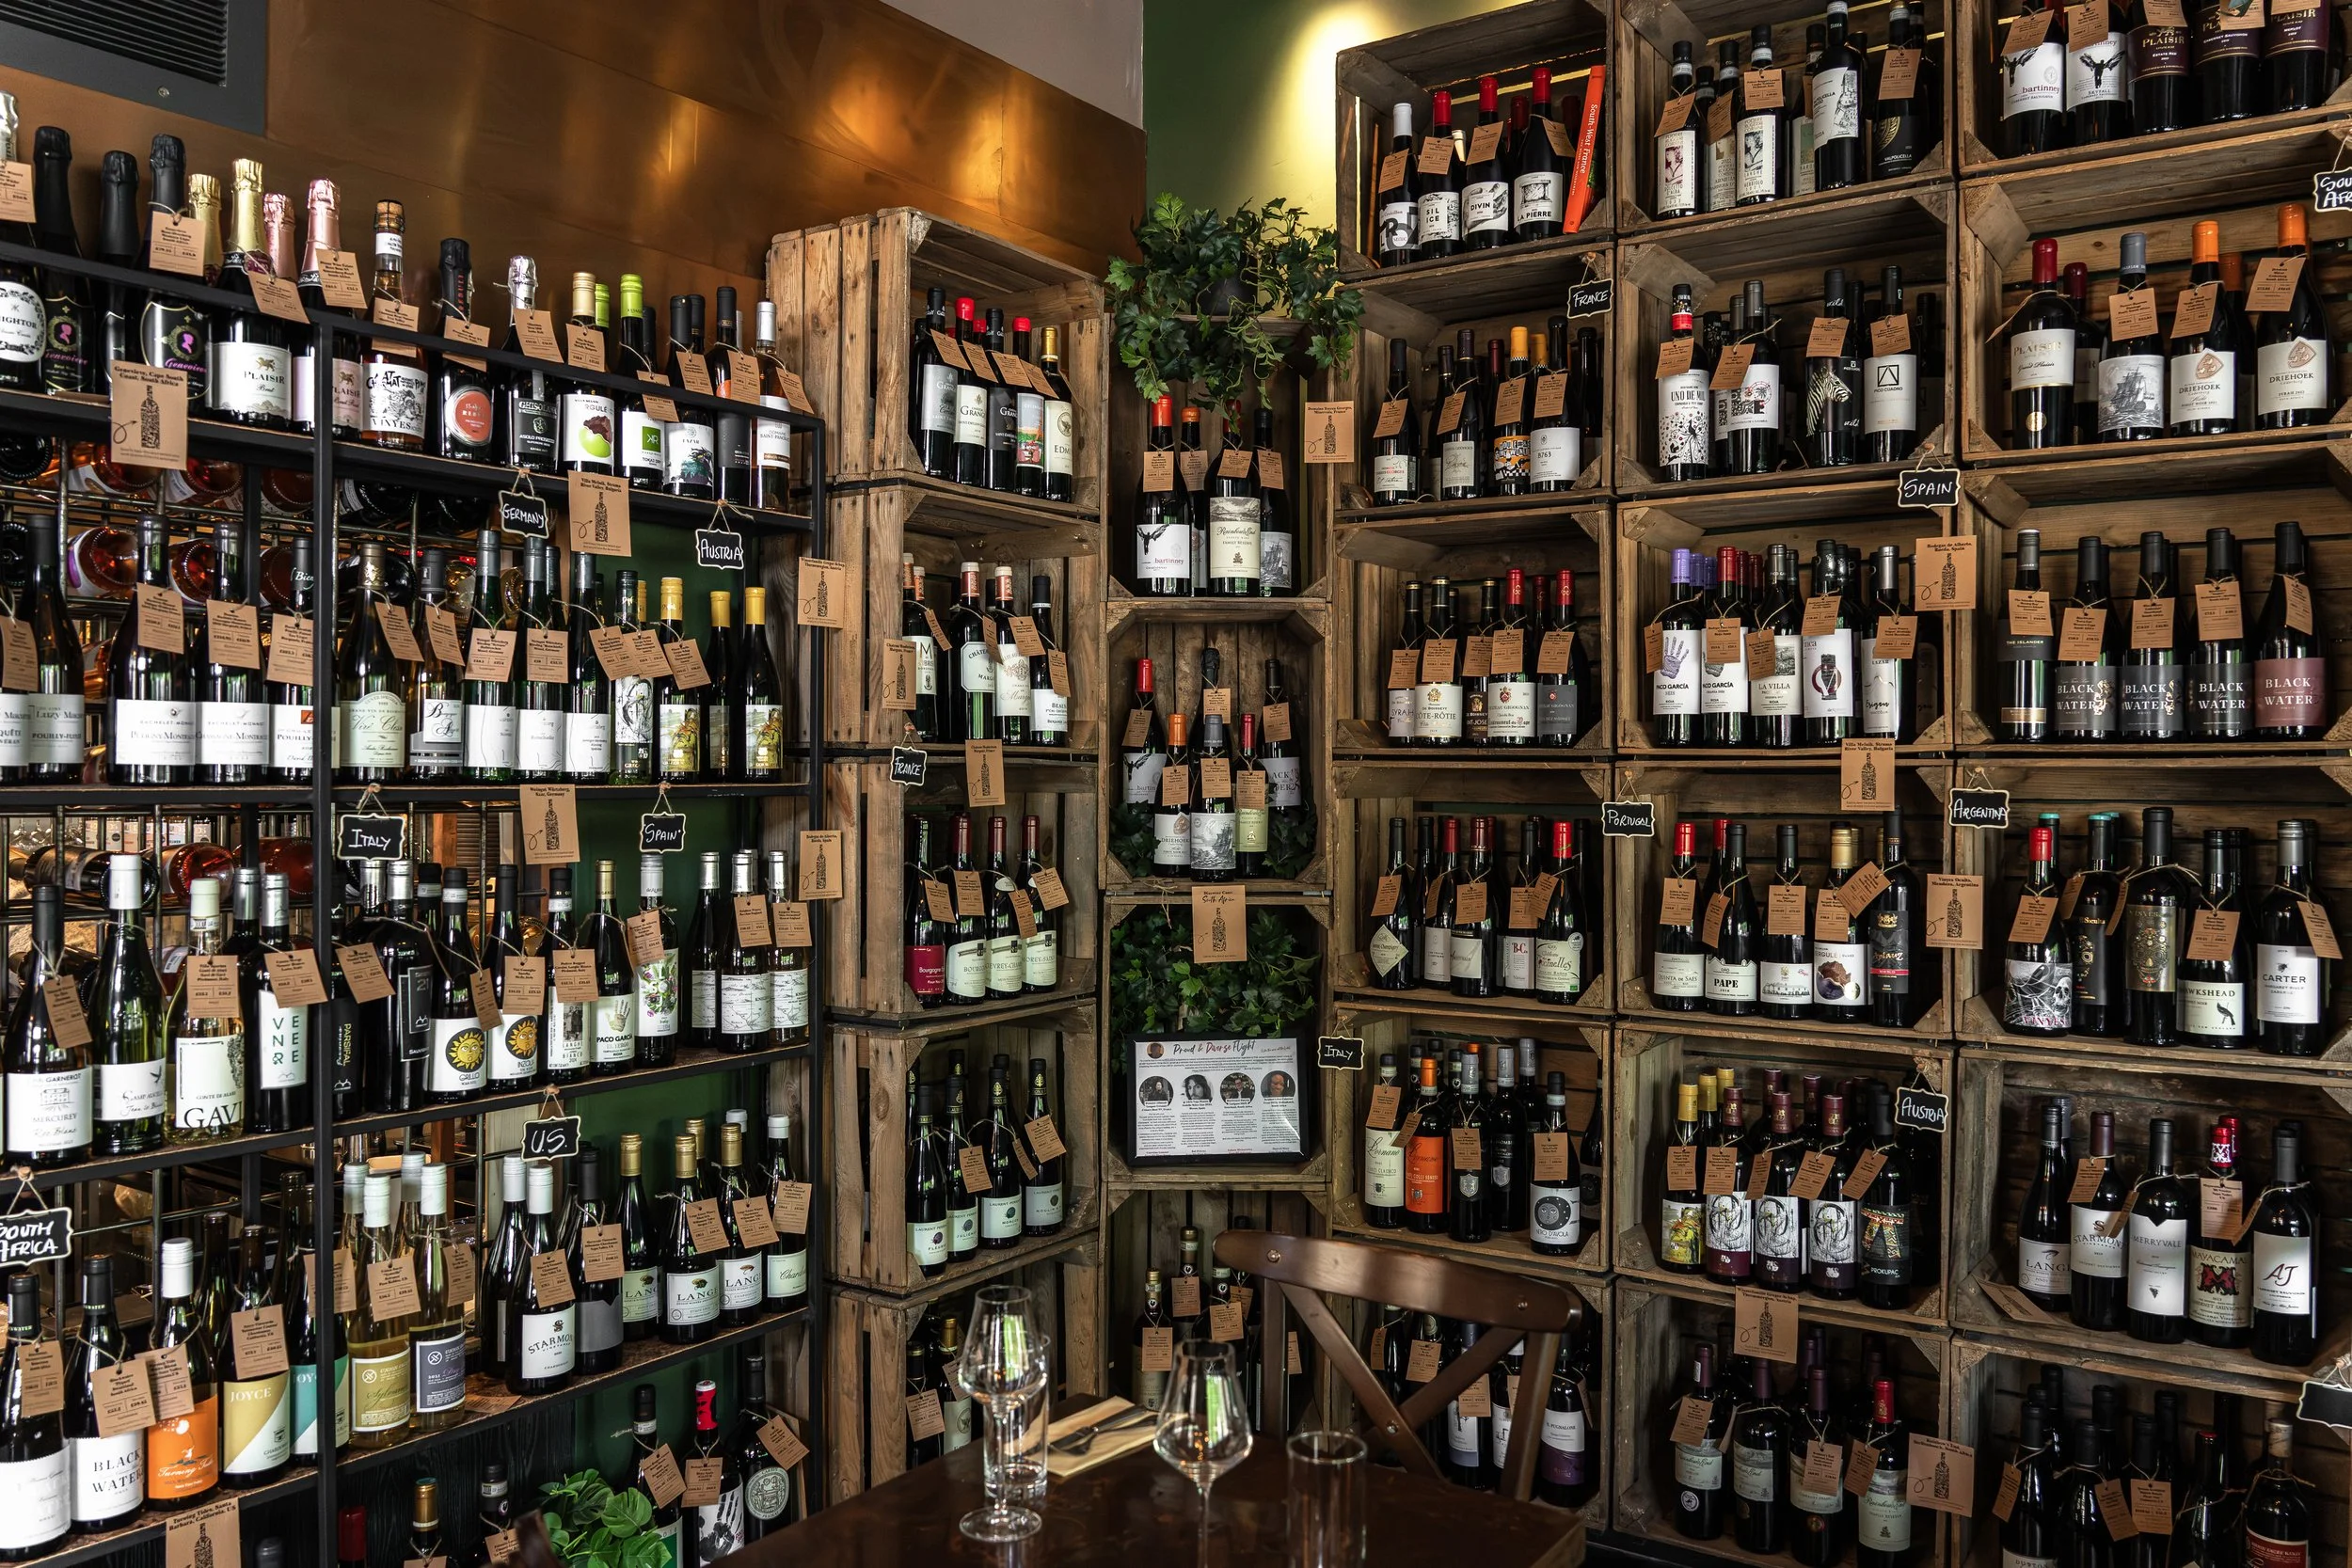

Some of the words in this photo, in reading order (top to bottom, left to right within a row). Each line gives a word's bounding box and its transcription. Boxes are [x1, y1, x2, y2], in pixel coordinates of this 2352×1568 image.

[2142, 36, 2185, 48] PLAISIR
[2022, 83, 2060, 95] bartinney
[2320, 177, 2352, 191] SOU
[1470, 201, 1491, 212] DIVIN
[1425, 214, 1440, 223] ICE
[1517, 214, 1525, 222] LA
[1526, 210, 1552, 218] PIERRE
[1574, 290, 1609, 308] FRANCE
[2268, 372, 2314, 384] DRIEHOEK
[2178, 383, 2221, 394] DRIEHOEK
[1904, 479, 1953, 498] SPAIN
[502, 502, 545, 527] GERMANY
[700, 540, 745, 561] AUSTRIA
[1154, 557, 1184, 565] bartinney
[968, 649, 988, 659] CHÂTE
[2057, 684, 2096, 694] BLACK
[2124, 684, 2167, 694] BLACK
[2199, 682, 2244, 693] BLACK
[2265, 676, 2311, 689] BLACK
[2056, 701, 2096, 710] WATER
[2123, 701, 2169, 710] WATER
[2198, 700, 2246, 709] WATER
[2264, 694, 2313, 706] WATER
[894, 755, 922, 776] FRANCE
[1954, 798, 2007, 821] ARGENTINA
[1608, 809, 1651, 828] PORTUGAL
[351, 829, 392, 851] ITALY
[645, 824, 677, 843] SPAIN
[1713, 978, 1739, 989] PAPE
[2263, 974, 2306, 984] CARTER
[342, 1023, 352, 1067] PARSIFAL
[1173, 1043, 1195, 1055] Proud
[1198, 1043, 1203, 1053] &
[1206, 1041, 1232, 1053] Diverse
[1232, 1039, 1256, 1056] Flight
[1325, 1044, 1353, 1061] ITALY
[184, 1101, 244, 1129] GAVI
[1901, 1098, 1946, 1122] AUSTRIA
[677, 1288, 719, 1302] LANGE
[230, 1386, 273, 1403] JOYCE
[94, 1448, 141, 1473] BLACK
